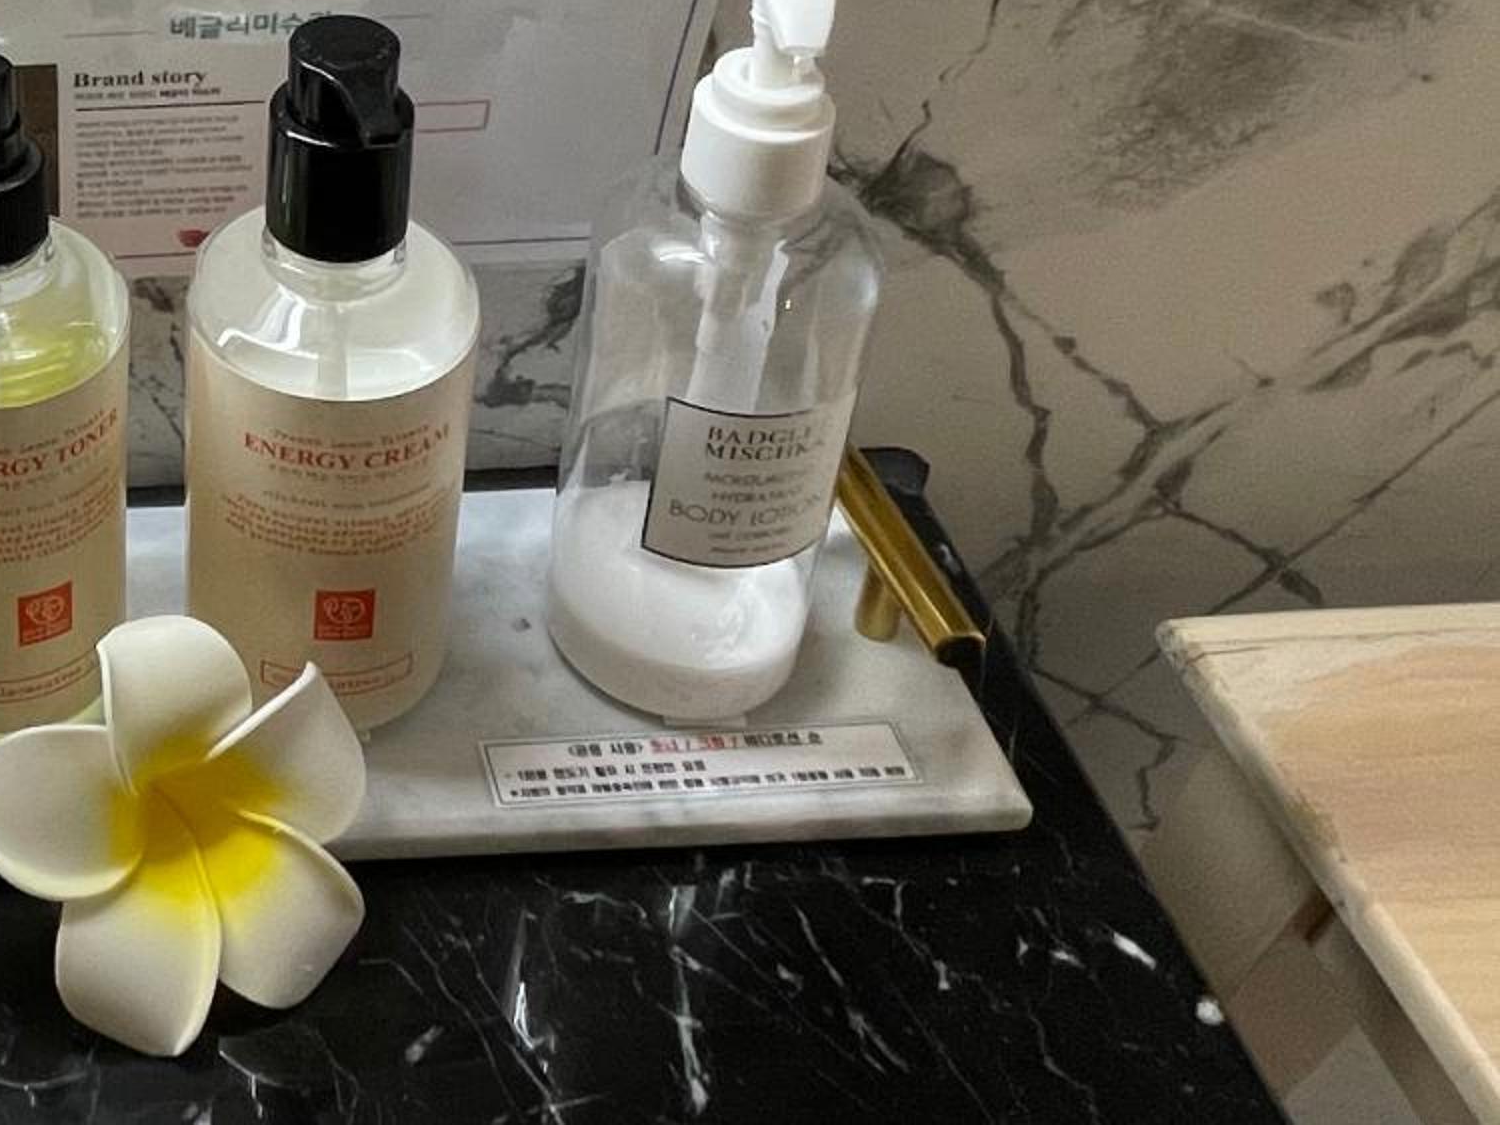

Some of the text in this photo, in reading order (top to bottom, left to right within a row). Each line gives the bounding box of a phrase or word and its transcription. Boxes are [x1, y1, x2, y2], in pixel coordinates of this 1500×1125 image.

[169, 11, 332, 40] 배글리미슈
[74, 70, 209, 88] Brand story
[244, 431, 356, 470] ENERGY
[669, 498, 741, 526] BODY
